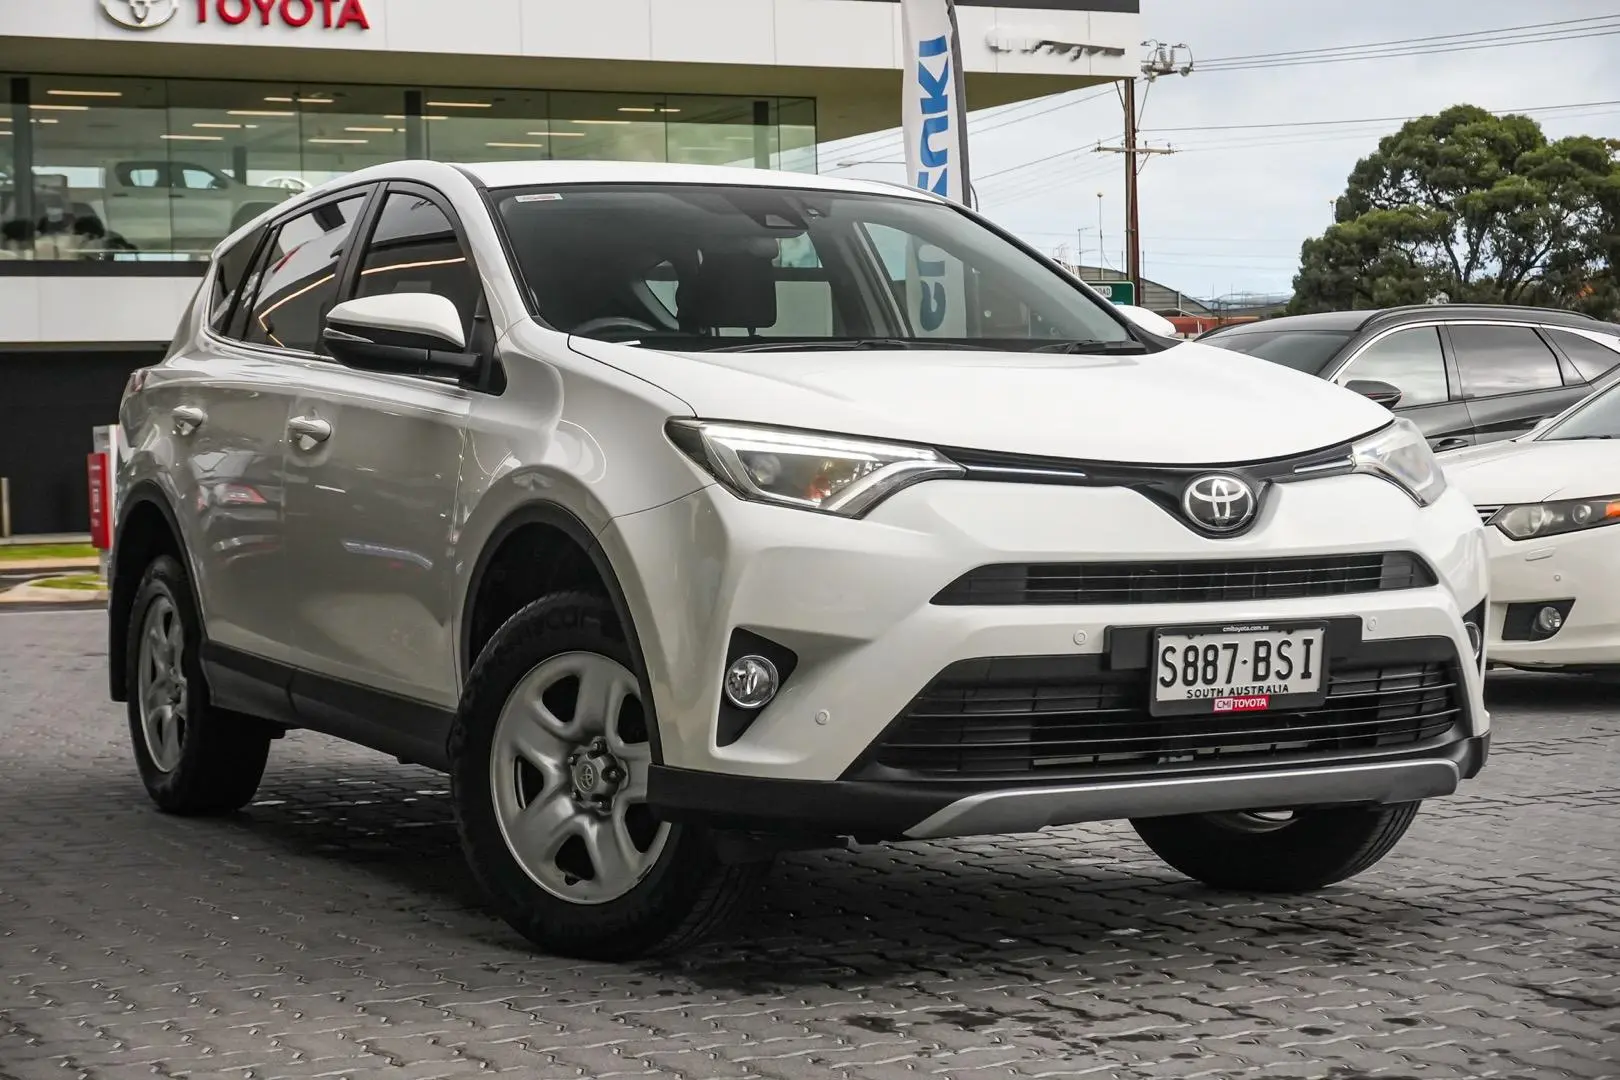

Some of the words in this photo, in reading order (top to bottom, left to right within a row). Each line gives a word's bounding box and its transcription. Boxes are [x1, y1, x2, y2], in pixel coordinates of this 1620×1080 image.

[196, 0, 369, 29] TOYOTA
[1187, 687, 1224, 699] SOUTH
[1228, 683, 1289, 697] AUSTRALIA
[1233, 698, 1268, 708] TOYOTA
